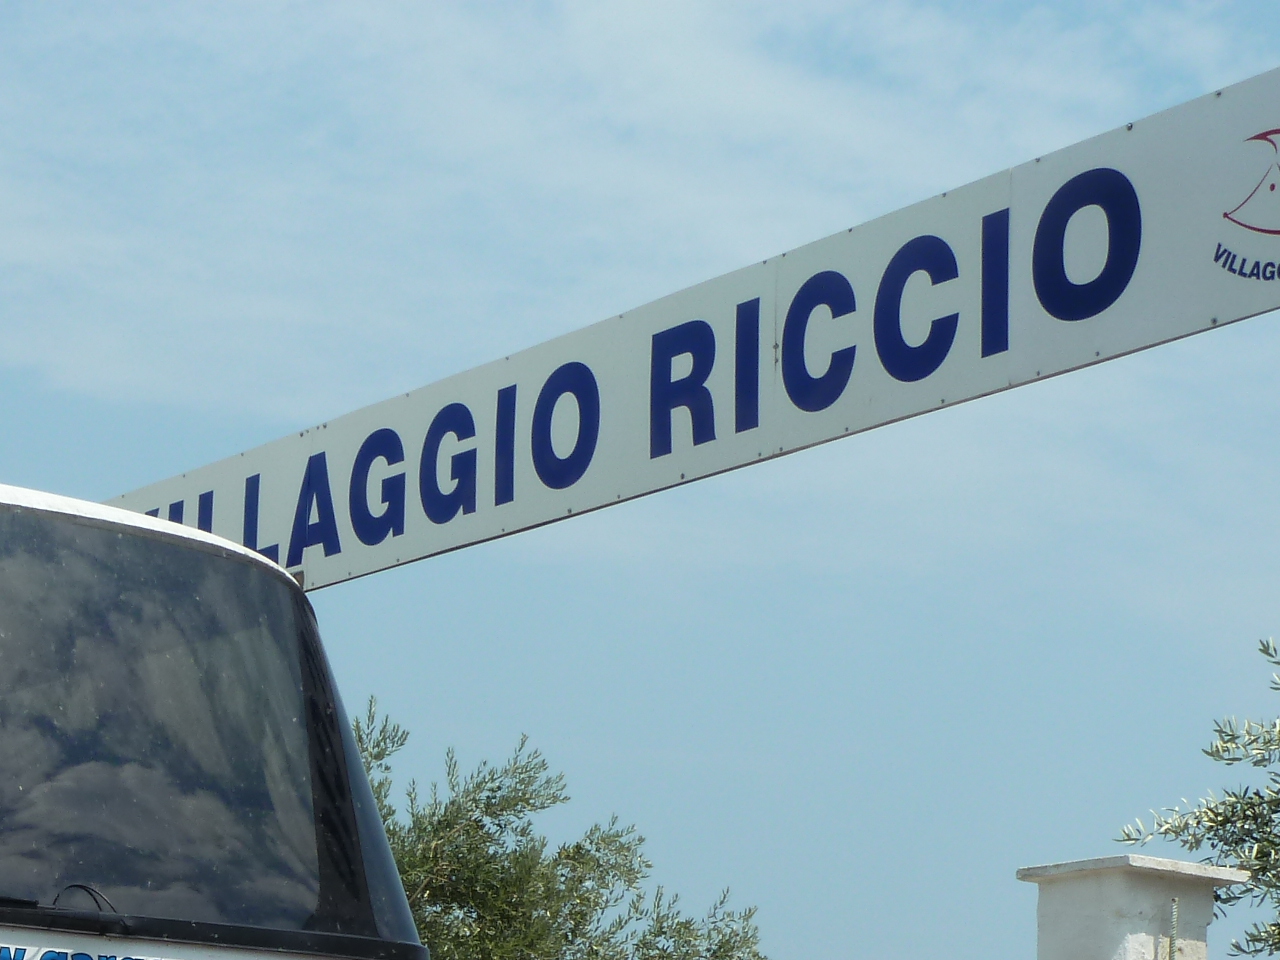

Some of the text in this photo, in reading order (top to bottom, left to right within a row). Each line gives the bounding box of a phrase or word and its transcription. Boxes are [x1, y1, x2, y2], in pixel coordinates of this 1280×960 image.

[144, 166, 1142, 568] LAGGIO RICCIO
[1213, 242, 1280, 281] VILLAG
